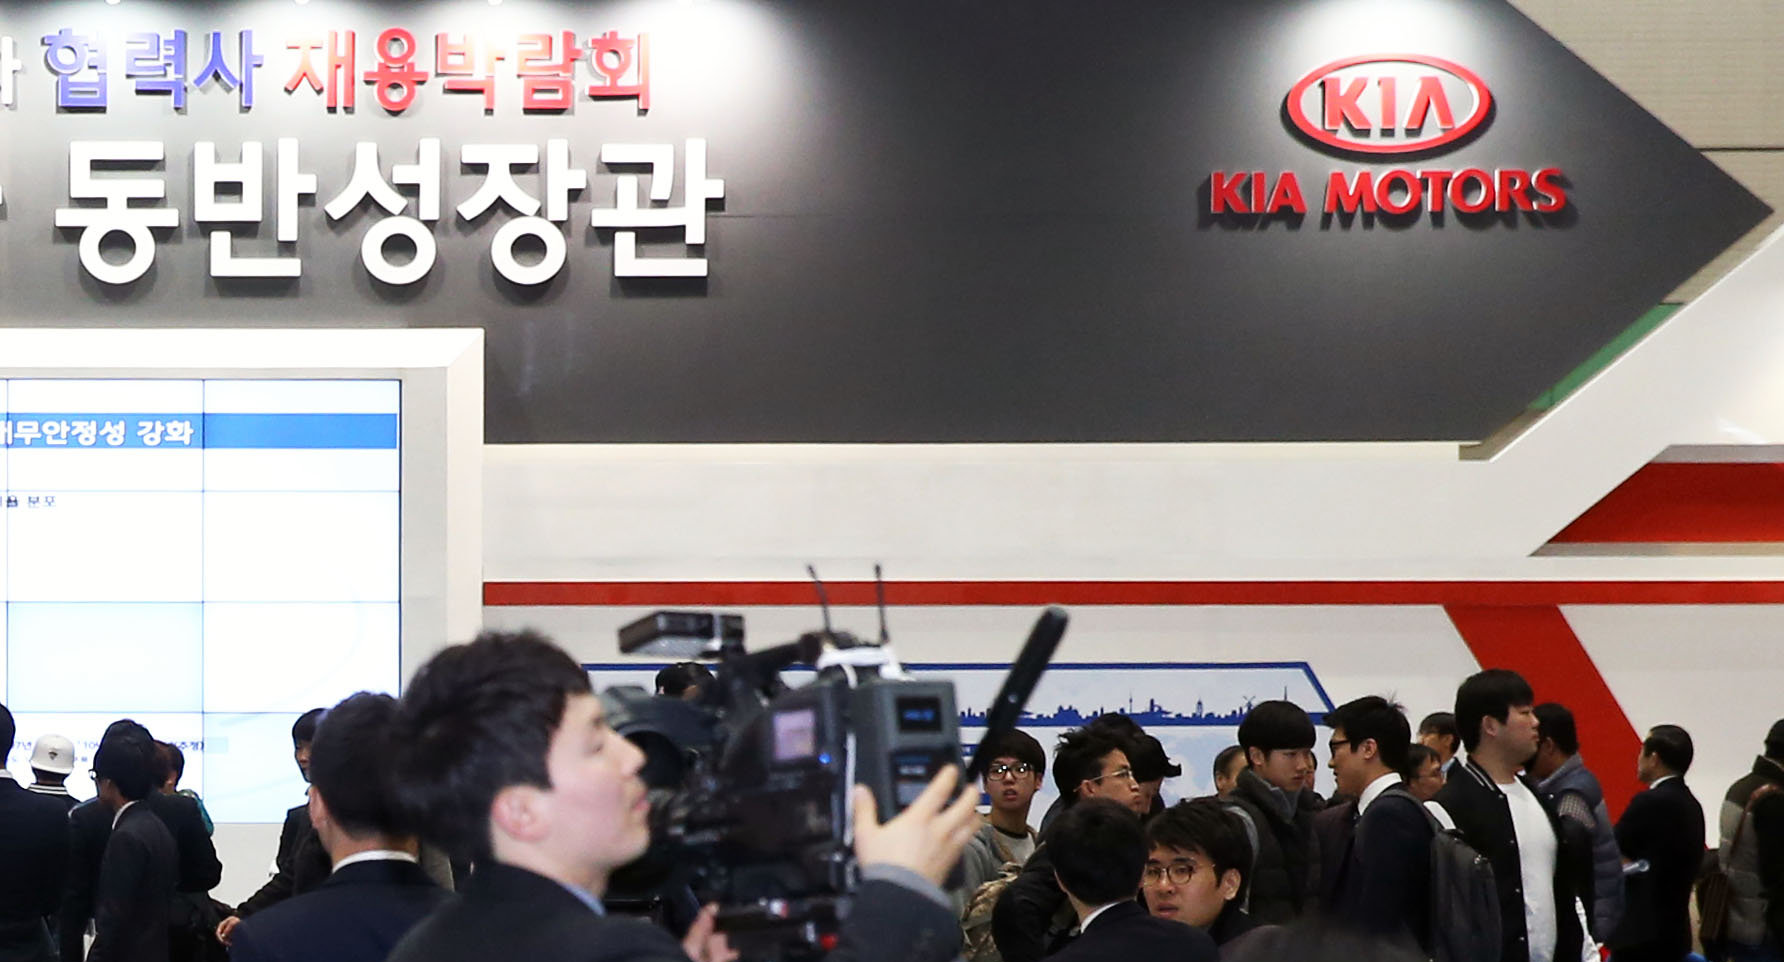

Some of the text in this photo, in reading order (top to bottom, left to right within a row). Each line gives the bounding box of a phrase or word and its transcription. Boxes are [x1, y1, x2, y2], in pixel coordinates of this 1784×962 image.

[41, 27, 264, 110] 협력사
[54, 137, 726, 286] 동반성장관
[1210, 168, 1568, 215] KIA MOTORS
[136, 419, 195, 447] 강화
